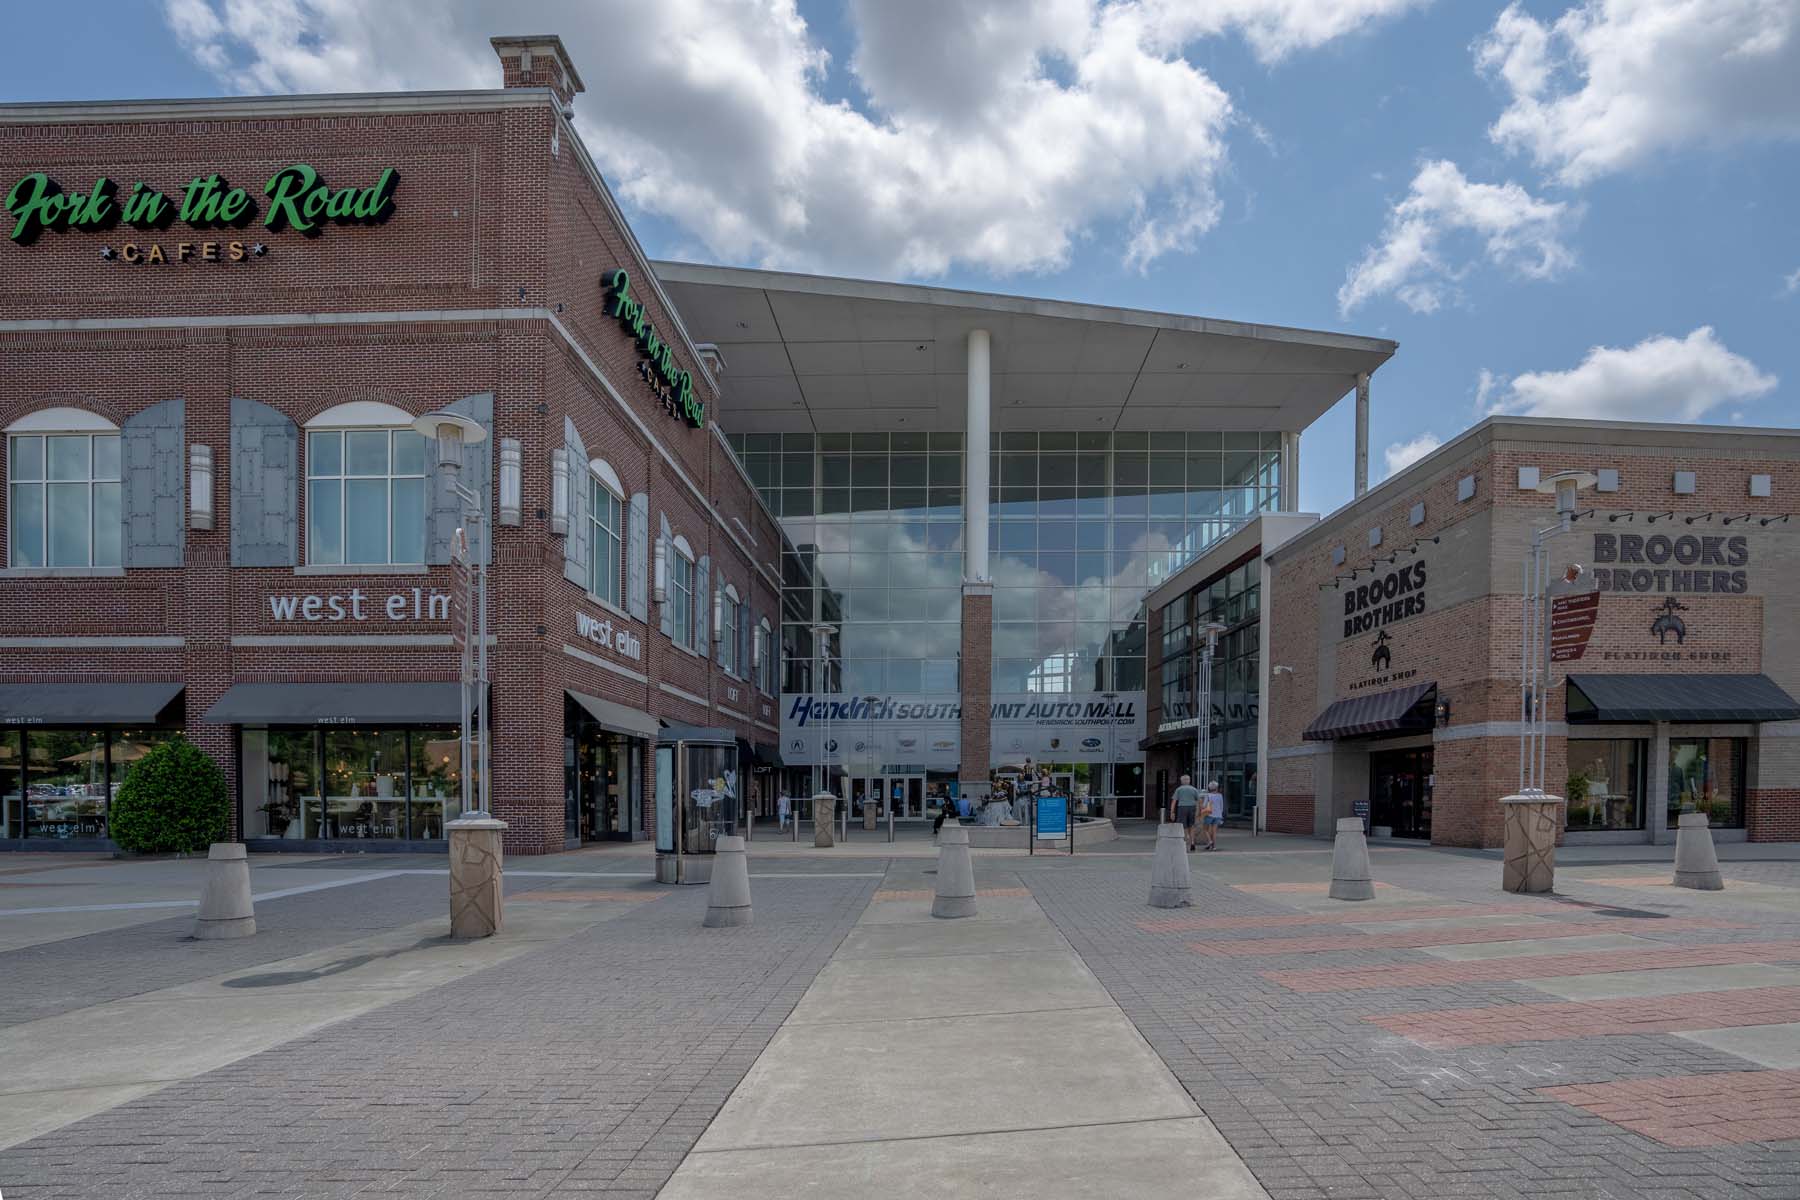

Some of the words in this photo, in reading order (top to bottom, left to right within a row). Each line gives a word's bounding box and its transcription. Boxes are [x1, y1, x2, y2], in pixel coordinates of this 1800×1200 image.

[6, 172, 113, 241] Fork
[122, 180, 169, 224] in
[178, 173, 250, 222] the
[262, 164, 395, 231] Road
[122, 241, 245, 262] CAFES
[613, 268, 646, 338] Fork
[647, 323, 660, 359] in
[661, 344, 678, 387] the
[679, 368, 705, 429] Road
[1593, 533, 1749, 567] BROOKS
[1344, 560, 1427, 616] BROOKS
[1593, 568, 1748, 594] BROTHERS
[269, 588, 369, 621] west
[386, 588, 452, 621] elm
[1343, 591, 1426, 638] BROTHERS
[575, 611, 613, 649] west
[615, 630, 641, 661] elm
[1603, 651, 1681, 661] FLATIRON
[1349, 677, 1389, 691] FLATIRON
[1392, 669, 1417, 681] SHOP
[317, 716, 338, 724] west
[788, 697, 897, 727] Hendrick
[1025, 703, 1081, 718] AUTO
[1082, 702, 1136, 718] MALL
[39, 822, 70, 834] west
[72, 822, 96, 834] elm
[338, 822, 369, 834] west
[372, 822, 395, 834] elm
